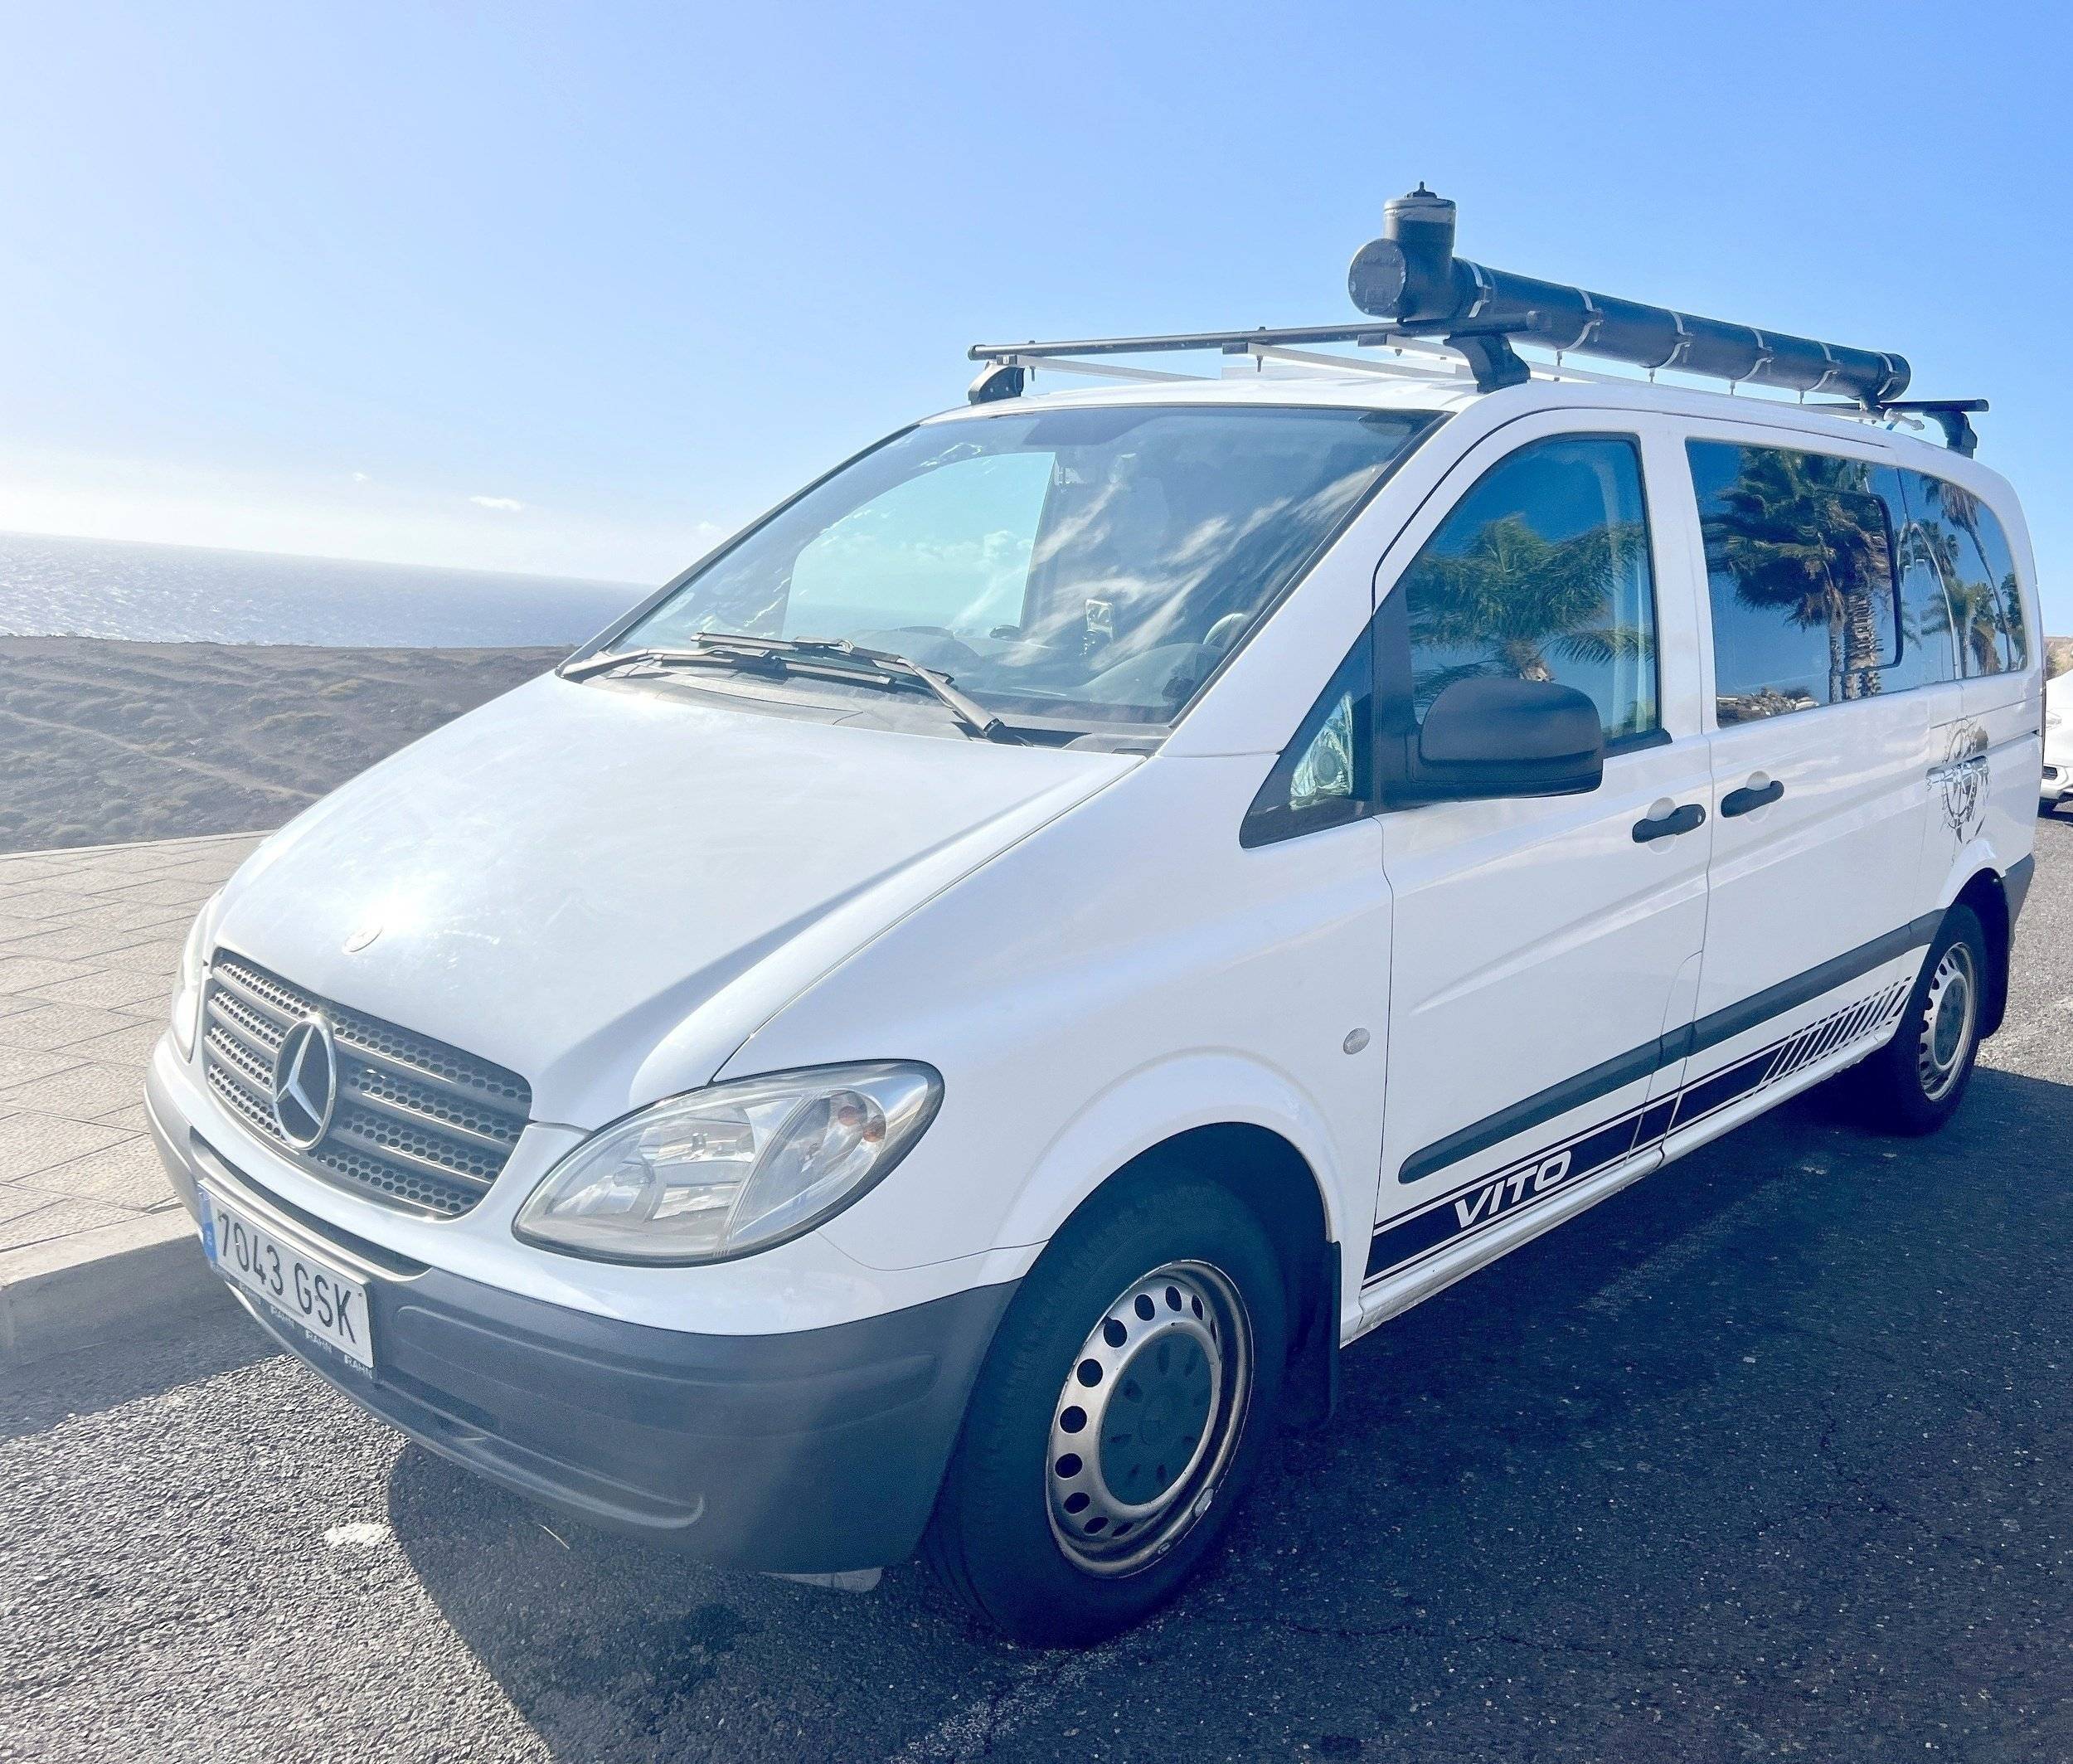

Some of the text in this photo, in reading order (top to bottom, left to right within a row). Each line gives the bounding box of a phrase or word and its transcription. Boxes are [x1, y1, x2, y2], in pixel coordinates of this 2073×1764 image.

[1454, 1150, 1571, 1228] VITO
[217, 1213, 356, 1344] 7043 GSK
